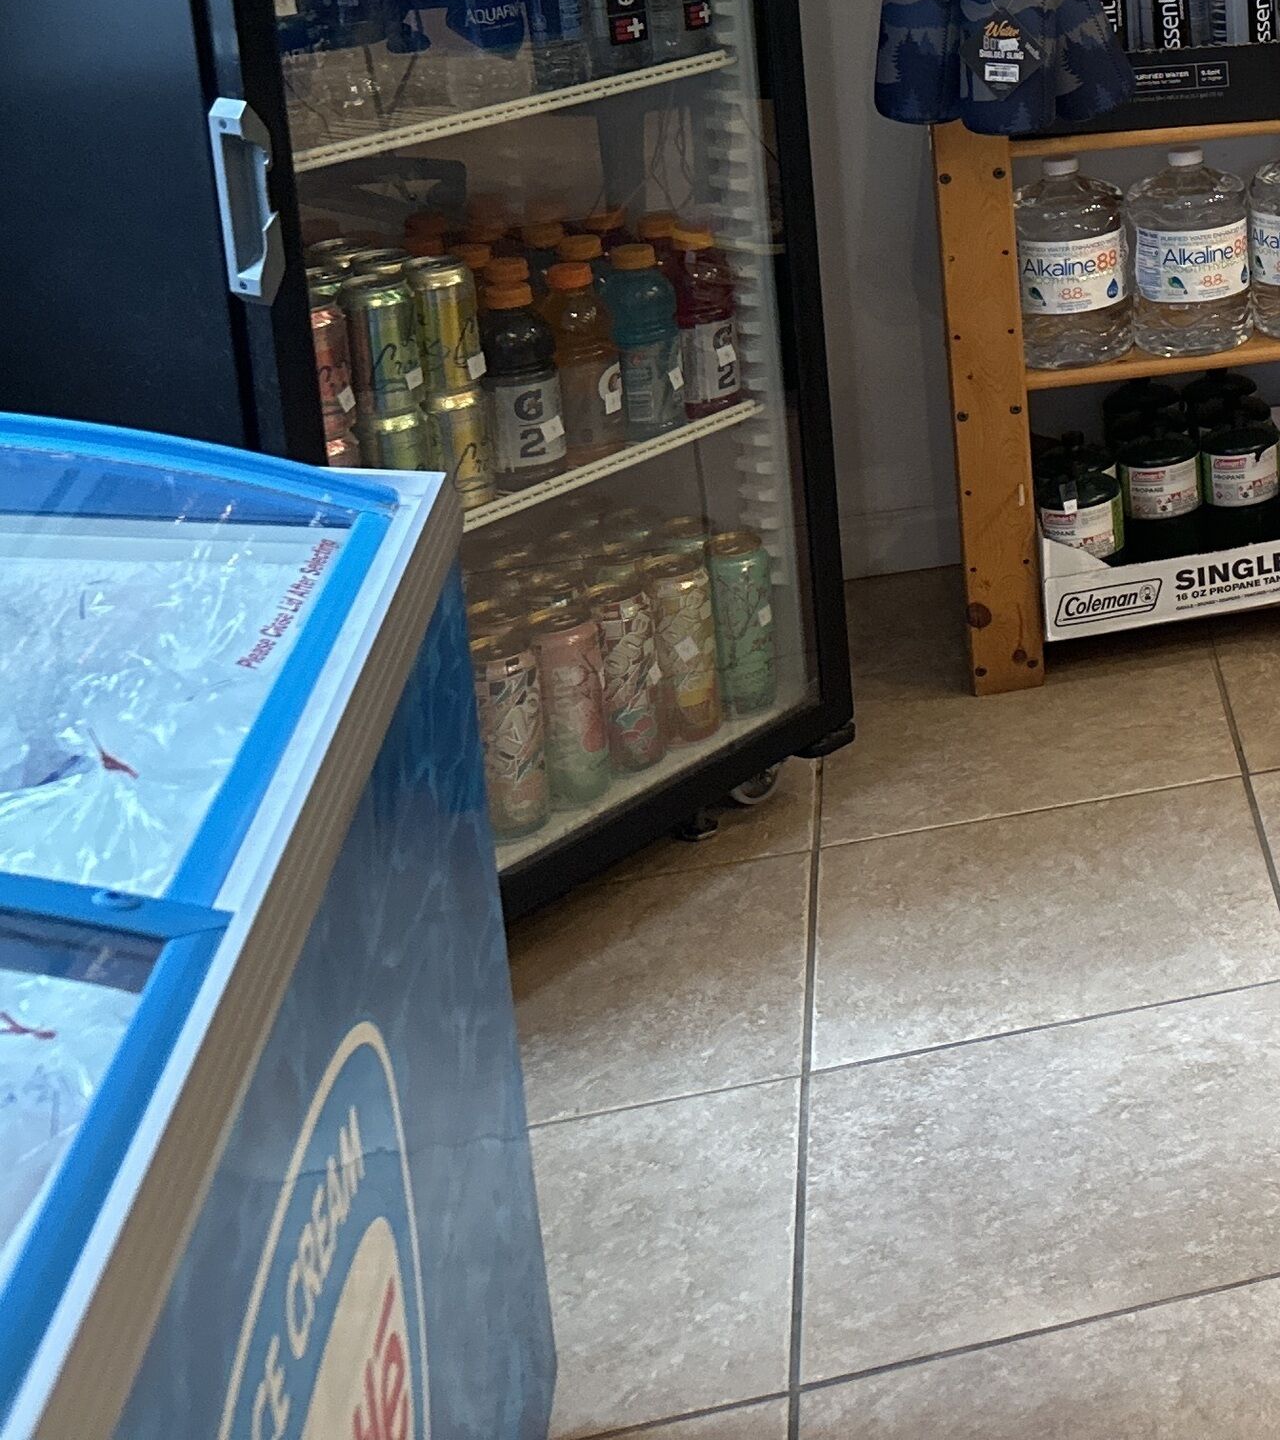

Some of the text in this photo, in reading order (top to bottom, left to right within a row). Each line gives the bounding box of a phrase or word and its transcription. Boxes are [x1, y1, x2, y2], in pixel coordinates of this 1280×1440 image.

[718, 361, 736, 389] 2
[513, 389, 545, 421] G
[519, 428, 547, 459] 2
[235, 538, 340, 670] Please Close Lid After Selecting
[1064, 593, 1138, 617] Coleman
[1175, 591, 1189, 602] 16
[1191, 588, 1207, 599] OZ
[1209, 579, 1262, 596] PROPANE
[285, 1103, 367, 1361] CREAM
